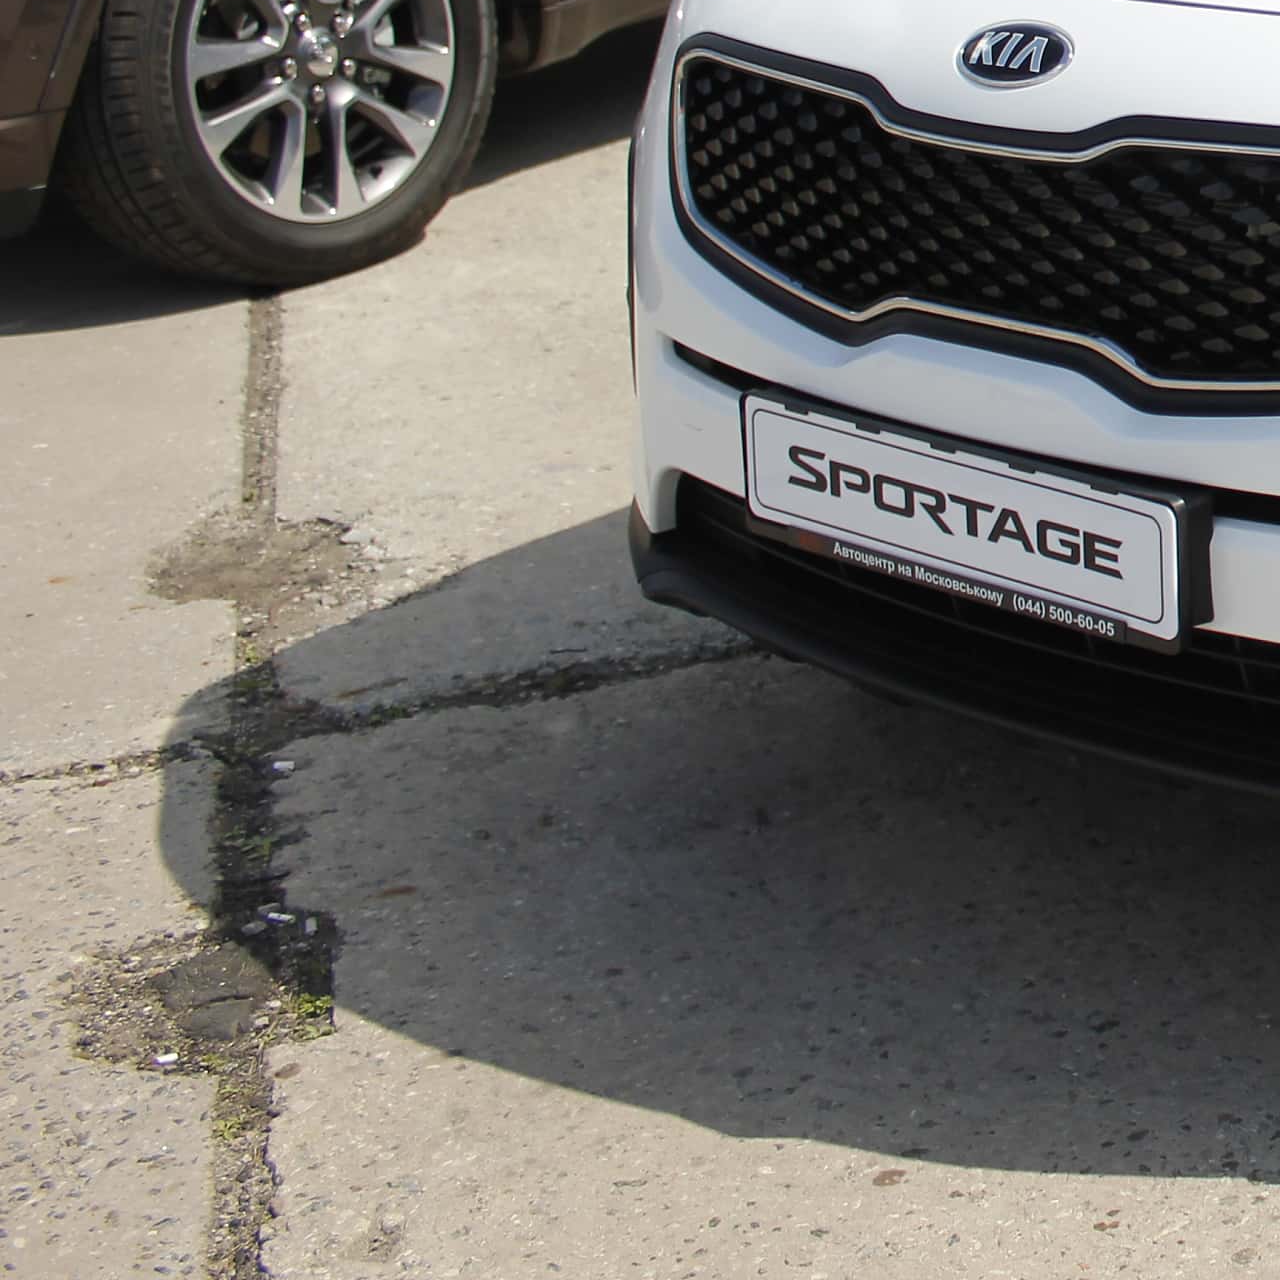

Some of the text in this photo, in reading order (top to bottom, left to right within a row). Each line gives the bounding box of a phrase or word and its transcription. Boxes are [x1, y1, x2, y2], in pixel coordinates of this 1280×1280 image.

[969, 31, 1048, 73] KIA
[787, 445, 1123, 580] SPORTAGE
[833, 541, 1115, 637] Автоцентр на Московському (044) 500-60-05
